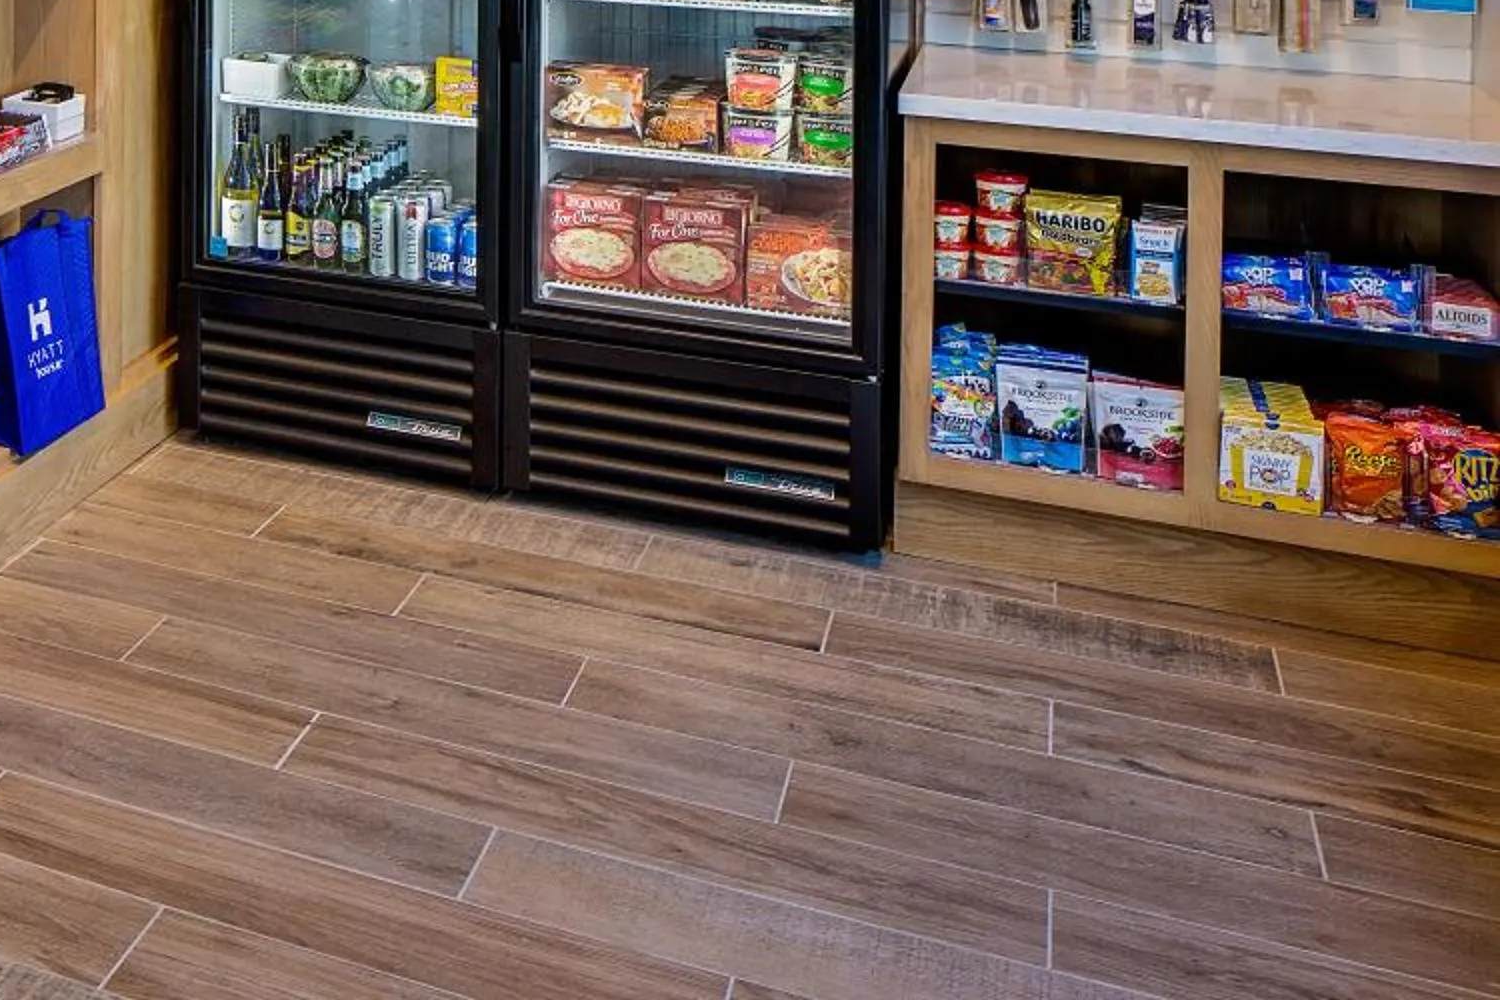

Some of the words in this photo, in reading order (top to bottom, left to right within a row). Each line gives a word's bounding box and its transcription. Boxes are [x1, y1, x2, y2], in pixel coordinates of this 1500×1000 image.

[1035, 210, 1106, 234] HARIBO
[372, 215, 383, 259] TRULY
[1435, 308, 1489, 326] ALTOIDS
[28, 338, 65, 370] HYATT
[1109, 404, 1176, 421] BROOKSIDE
[1453, 451, 1500, 486] RITZ
